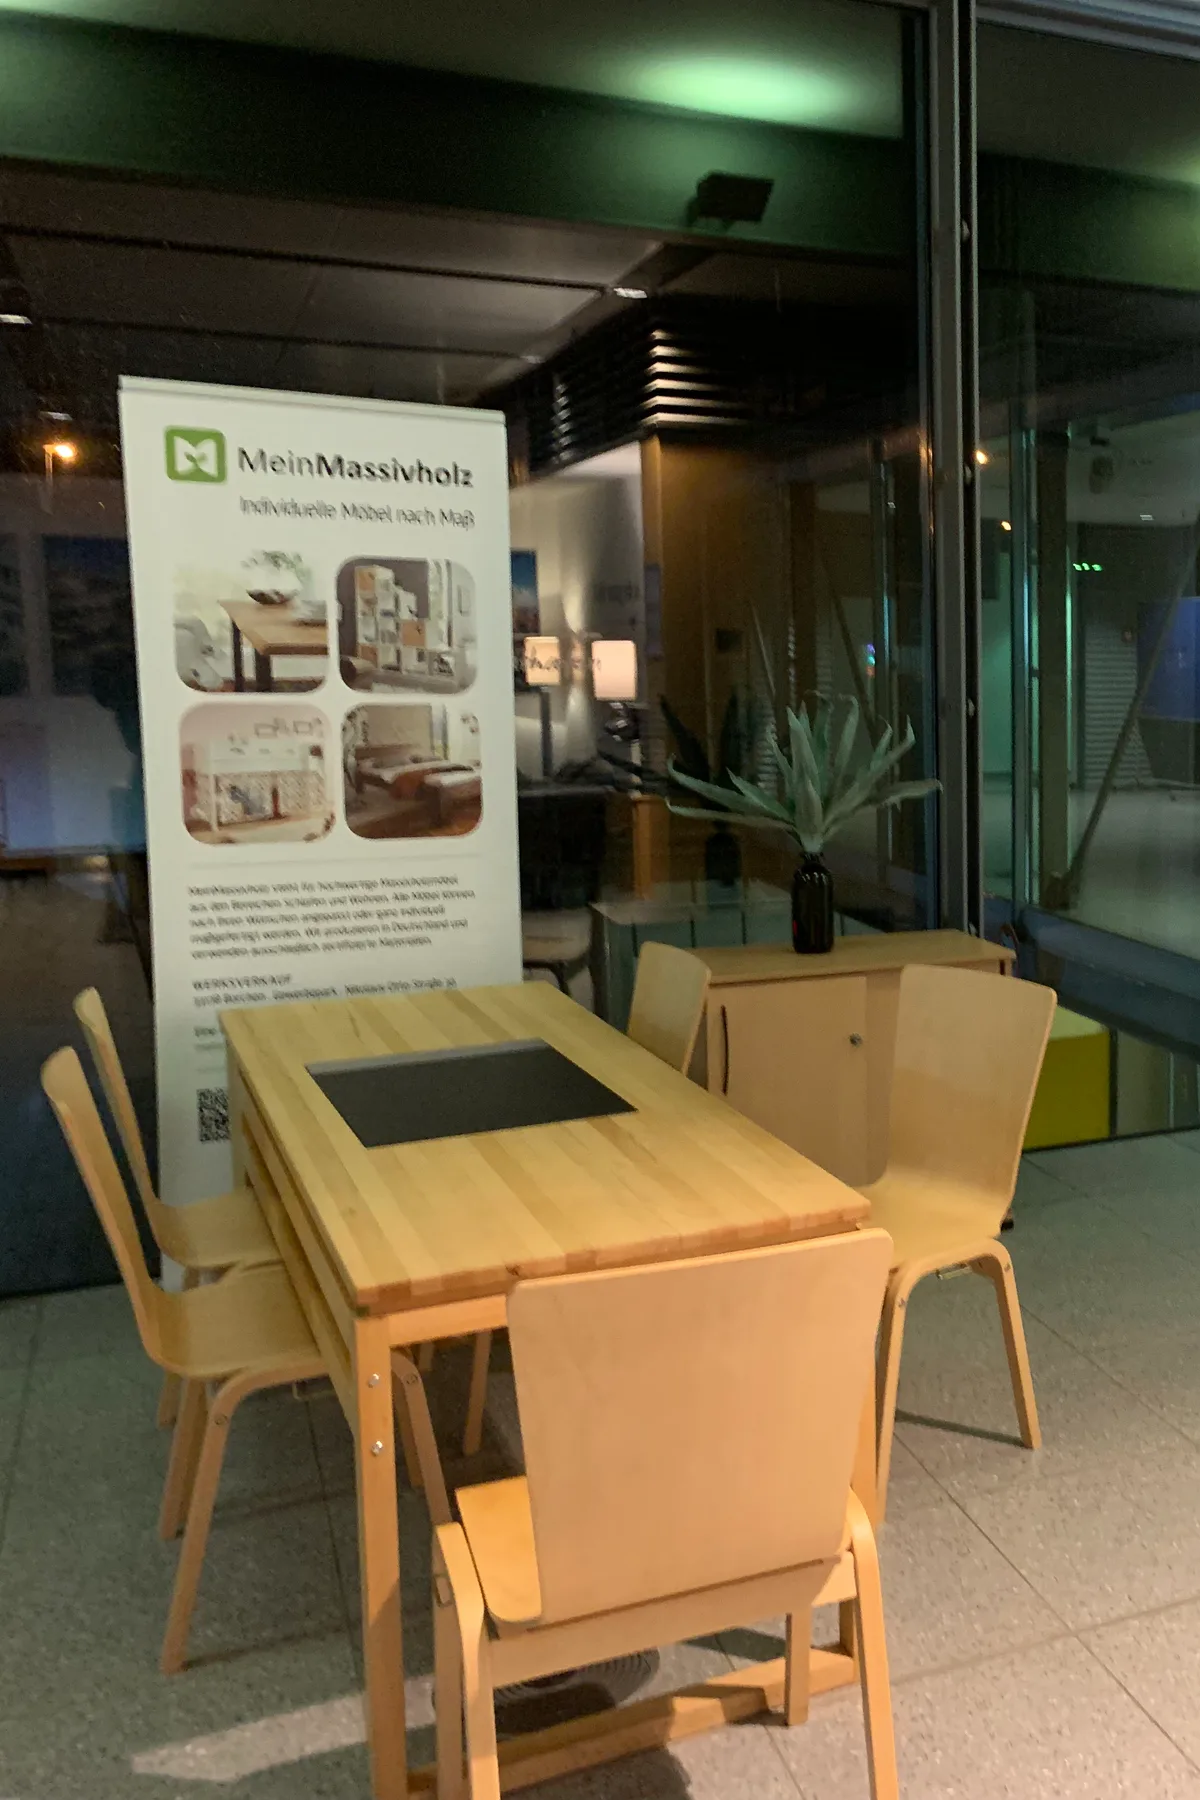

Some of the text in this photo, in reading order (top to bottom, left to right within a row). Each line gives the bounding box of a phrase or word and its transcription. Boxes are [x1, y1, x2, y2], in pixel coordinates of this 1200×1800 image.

[238, 447, 474, 488] MeinMassivholz
[240, 496, 337, 519] Individuelle
[341, 502, 393, 524] Möbel
[396, 507, 436, 526] nach
